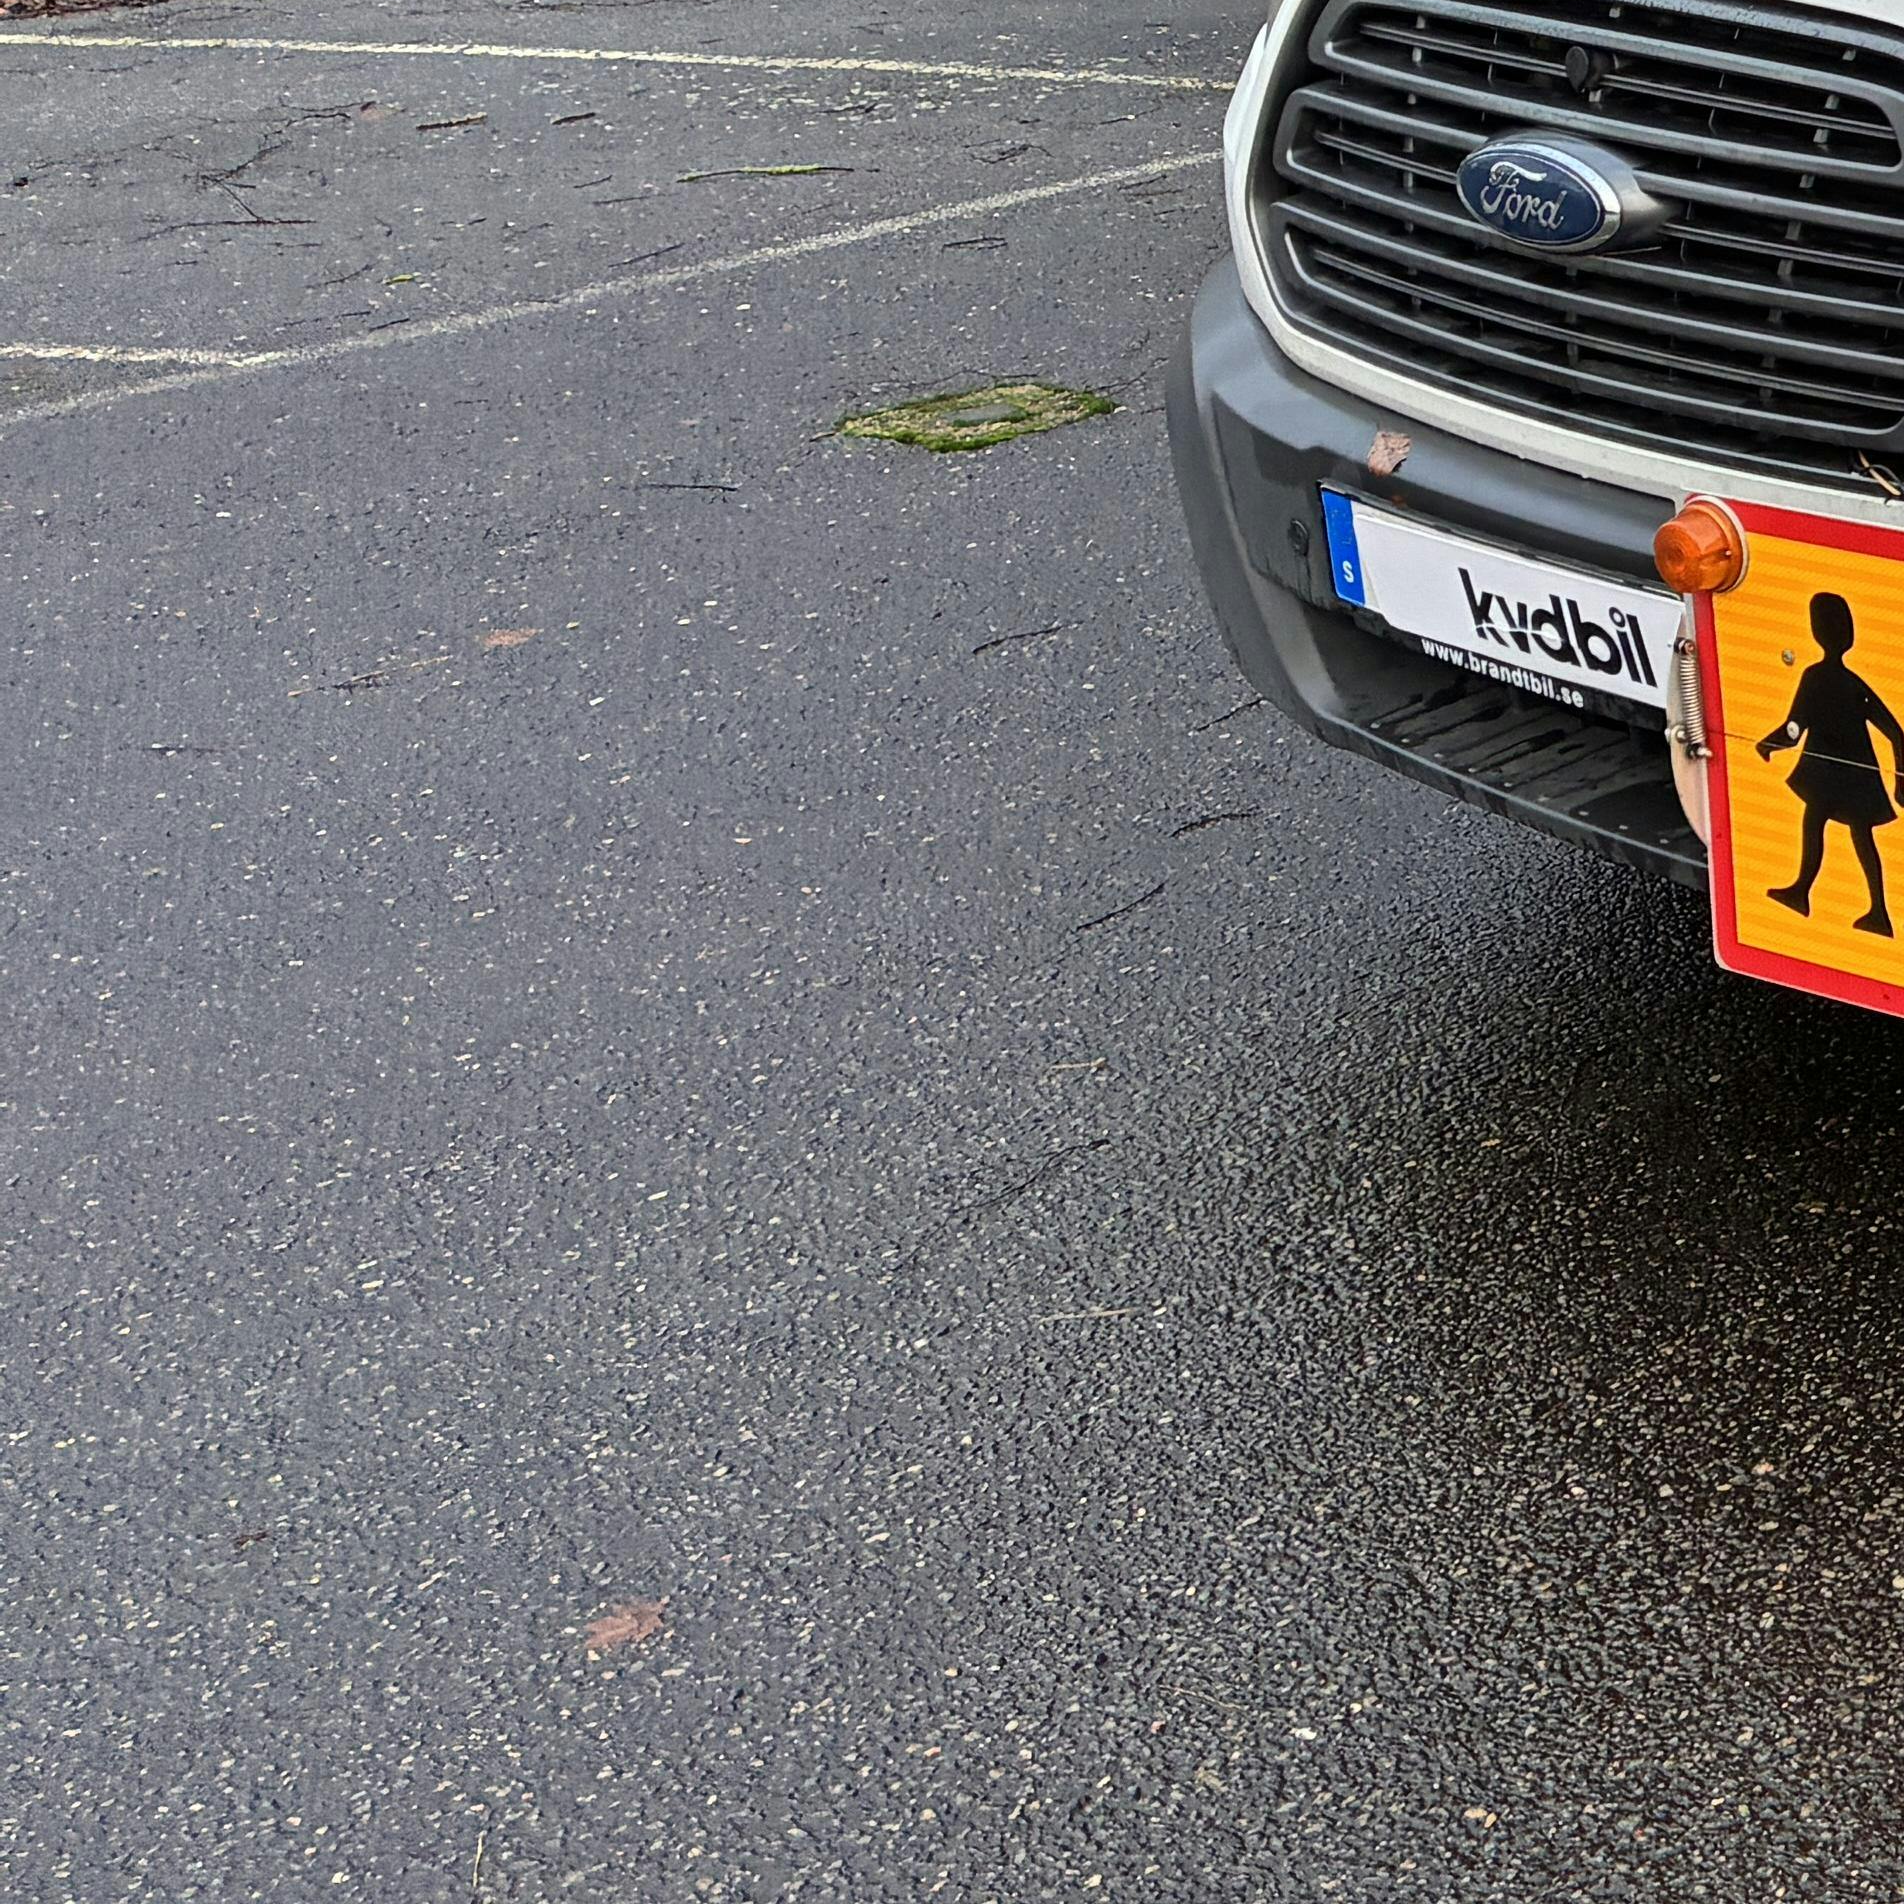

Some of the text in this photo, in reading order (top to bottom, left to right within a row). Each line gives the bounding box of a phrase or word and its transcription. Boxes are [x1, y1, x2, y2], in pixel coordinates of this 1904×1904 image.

[1480, 161, 1567, 230] Ford
[1342, 560, 1354, 583] S
[1458, 567, 1658, 688] kvdbil
[1421, 638, 1584, 708] www.brandtbil.se
